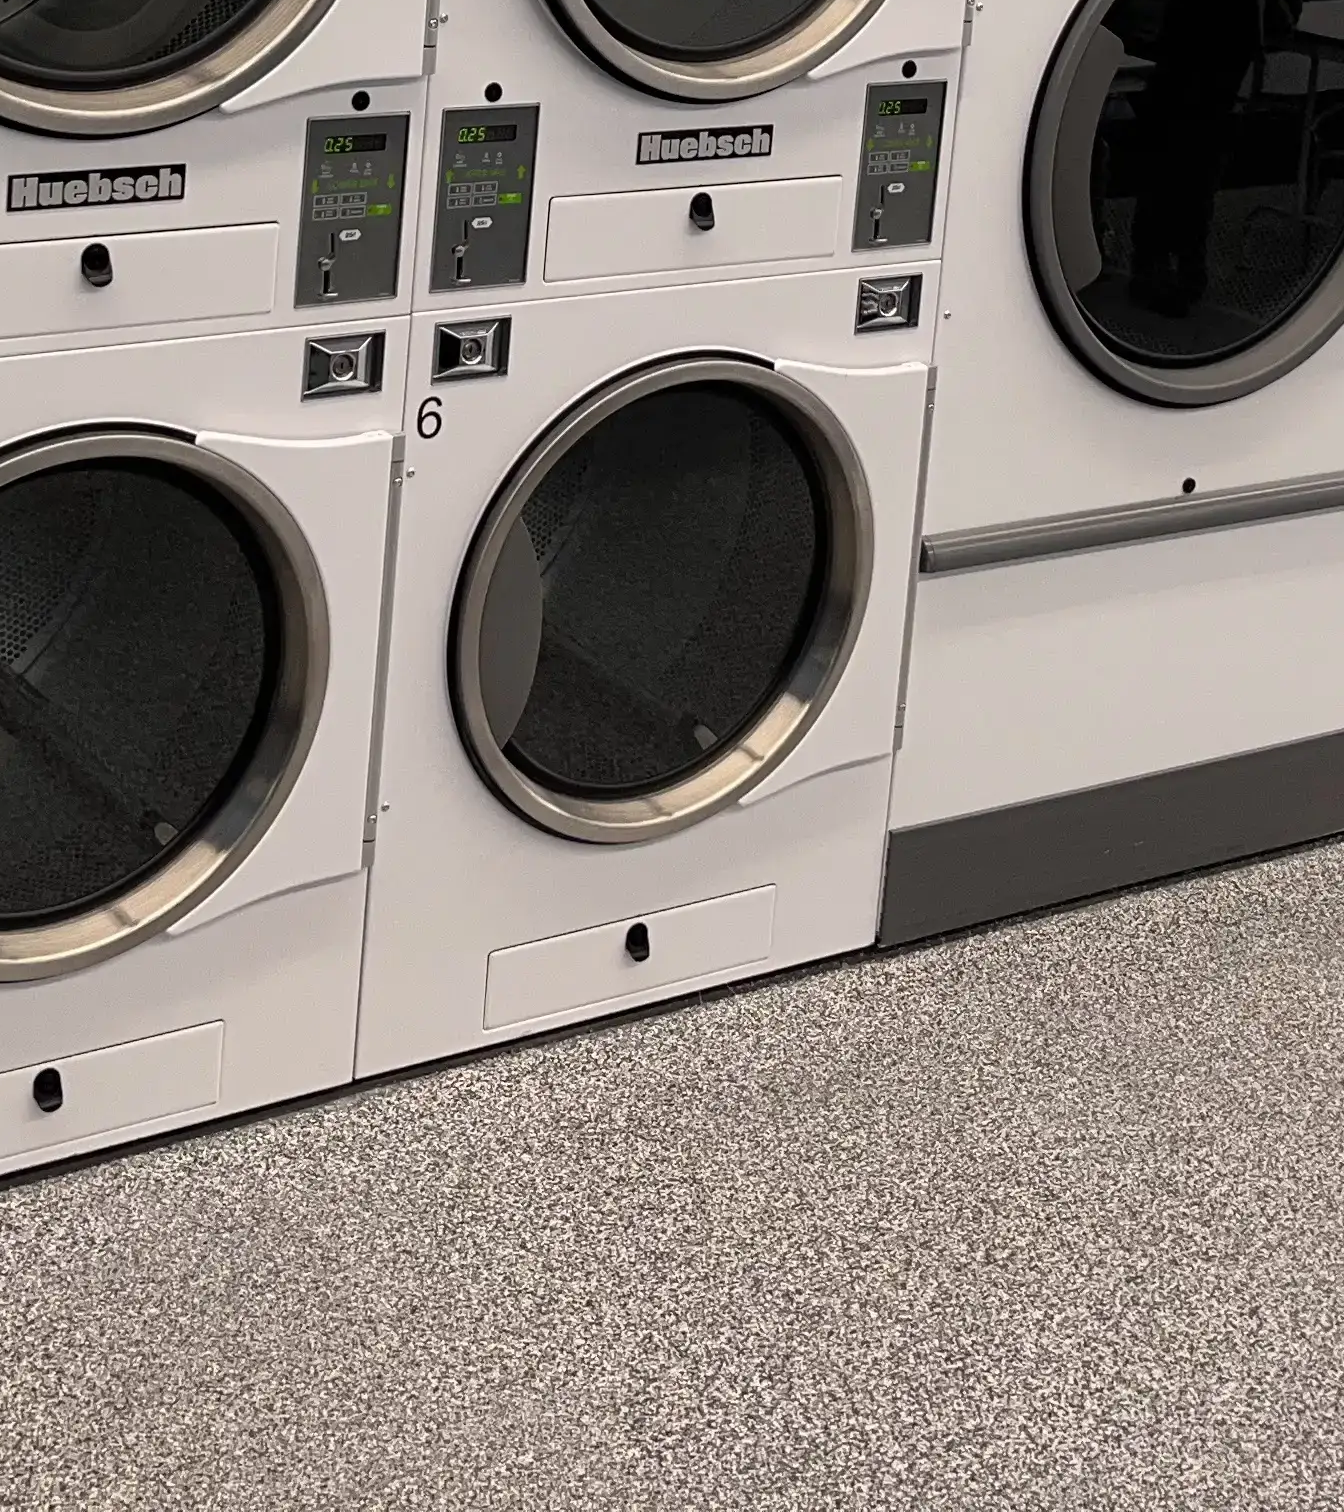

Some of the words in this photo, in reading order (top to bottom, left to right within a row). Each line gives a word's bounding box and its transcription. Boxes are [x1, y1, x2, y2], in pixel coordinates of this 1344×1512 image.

[639, 128, 771, 162] Huebsch
[10, 167, 183, 209] Huebsch
[416, 396, 443, 440] 6
